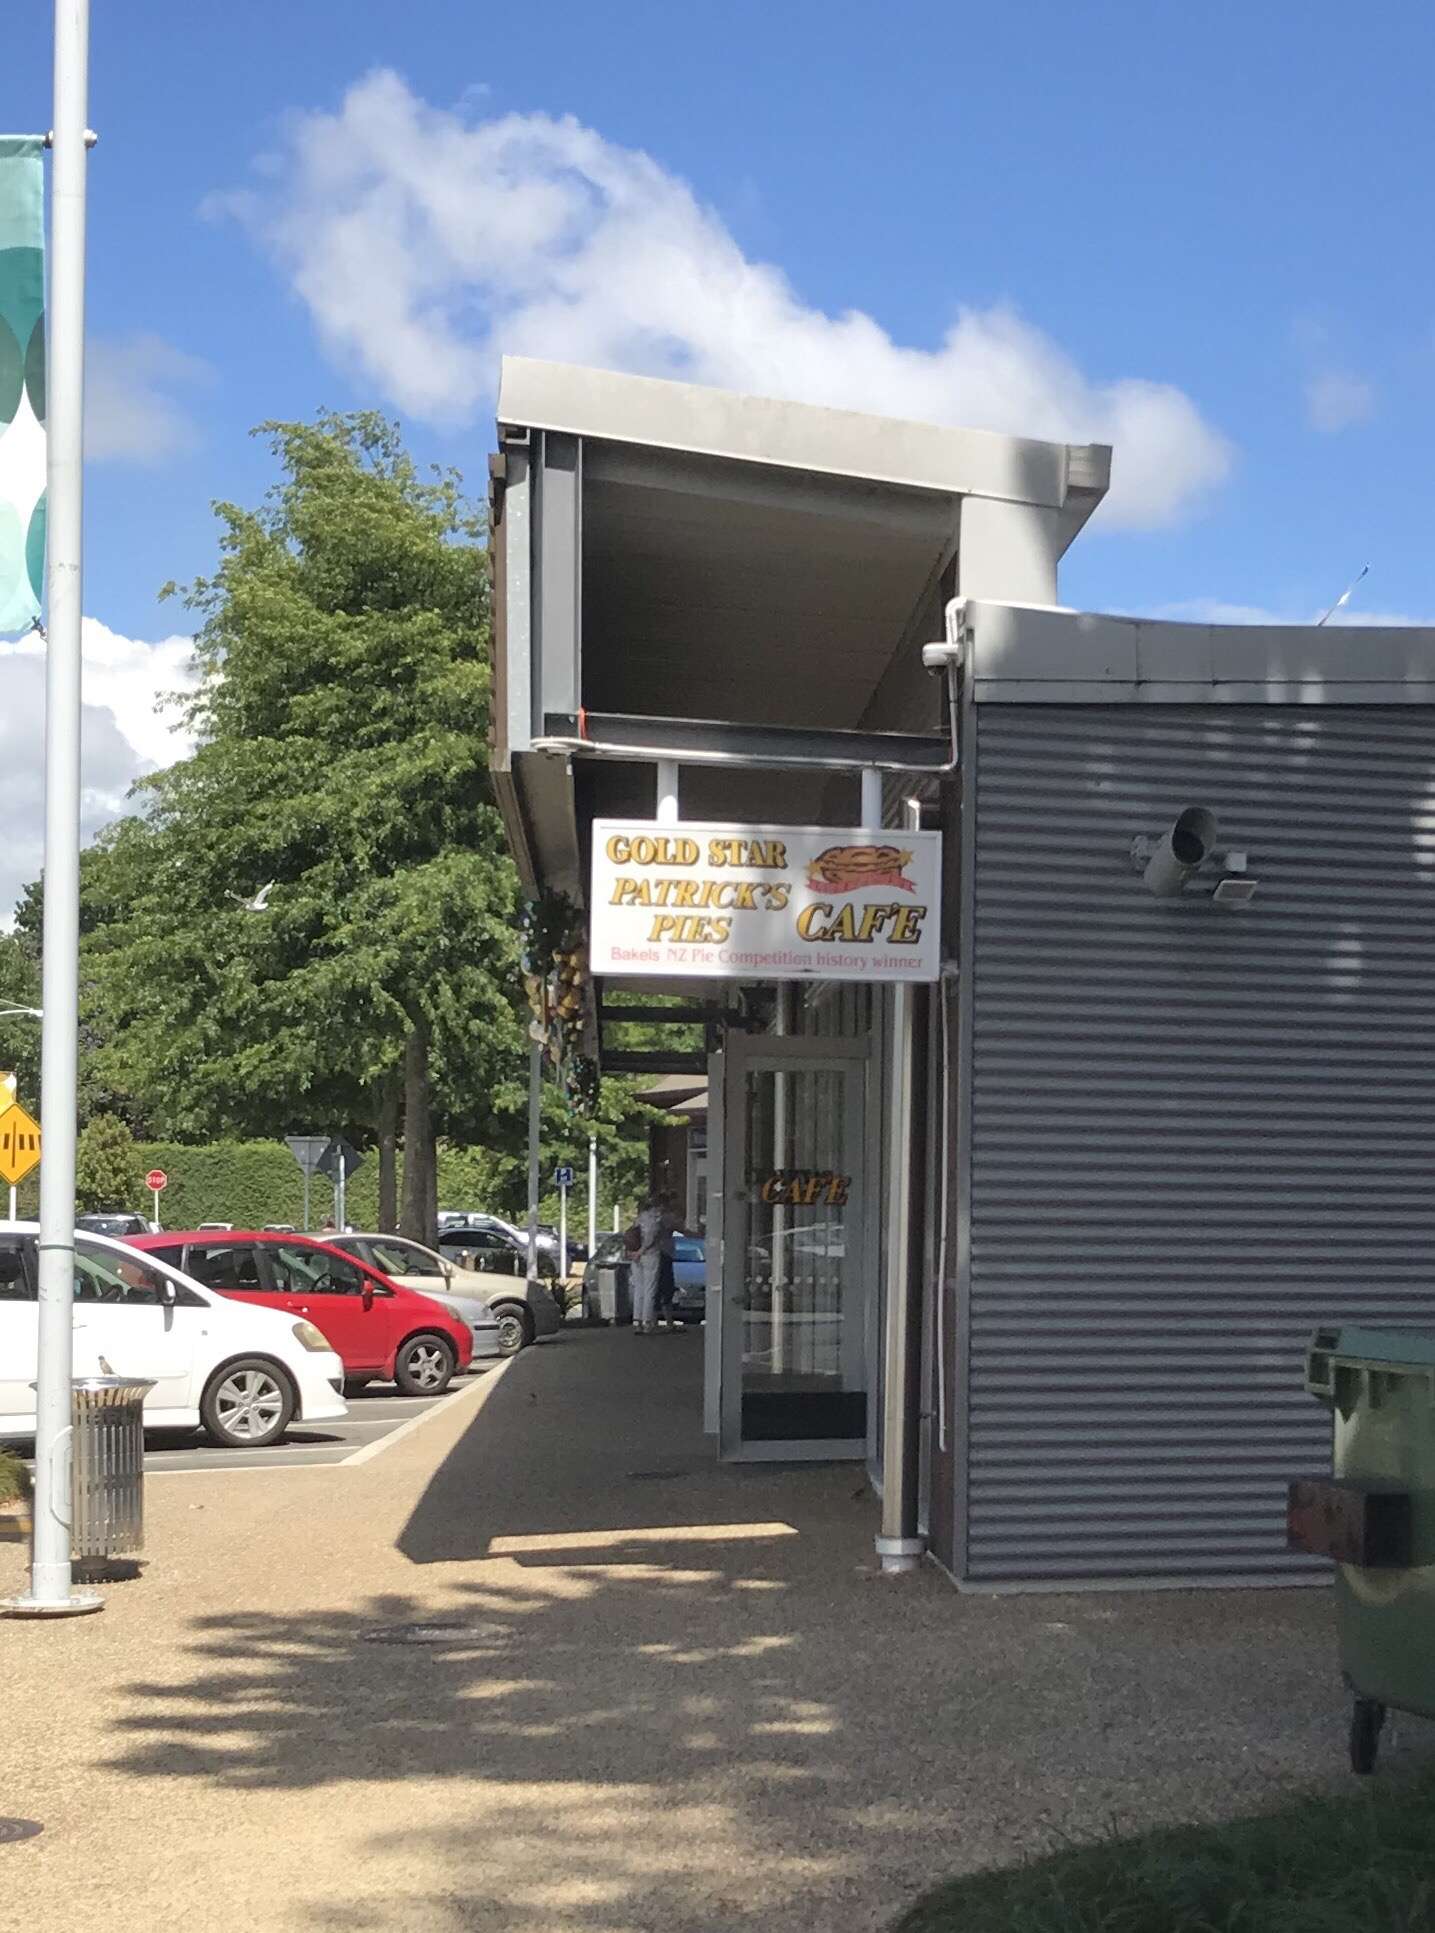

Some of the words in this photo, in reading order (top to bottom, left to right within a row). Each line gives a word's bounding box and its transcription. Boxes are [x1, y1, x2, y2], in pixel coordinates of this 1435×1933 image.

[606, 835, 700, 866] GOLD
[708, 838, 789, 870] STAR
[608, 877, 792, 911] PATRICK'S
[647, 914, 733, 944] PIES
[610, 946, 660, 962] Bakels
[667, 948, 689, 963] NZ
[692, 948, 714, 964] Pie
[718, 949, 812, 968] Competition
[816, 951, 867, 971] history
[872, 953, 923, 969] winner
